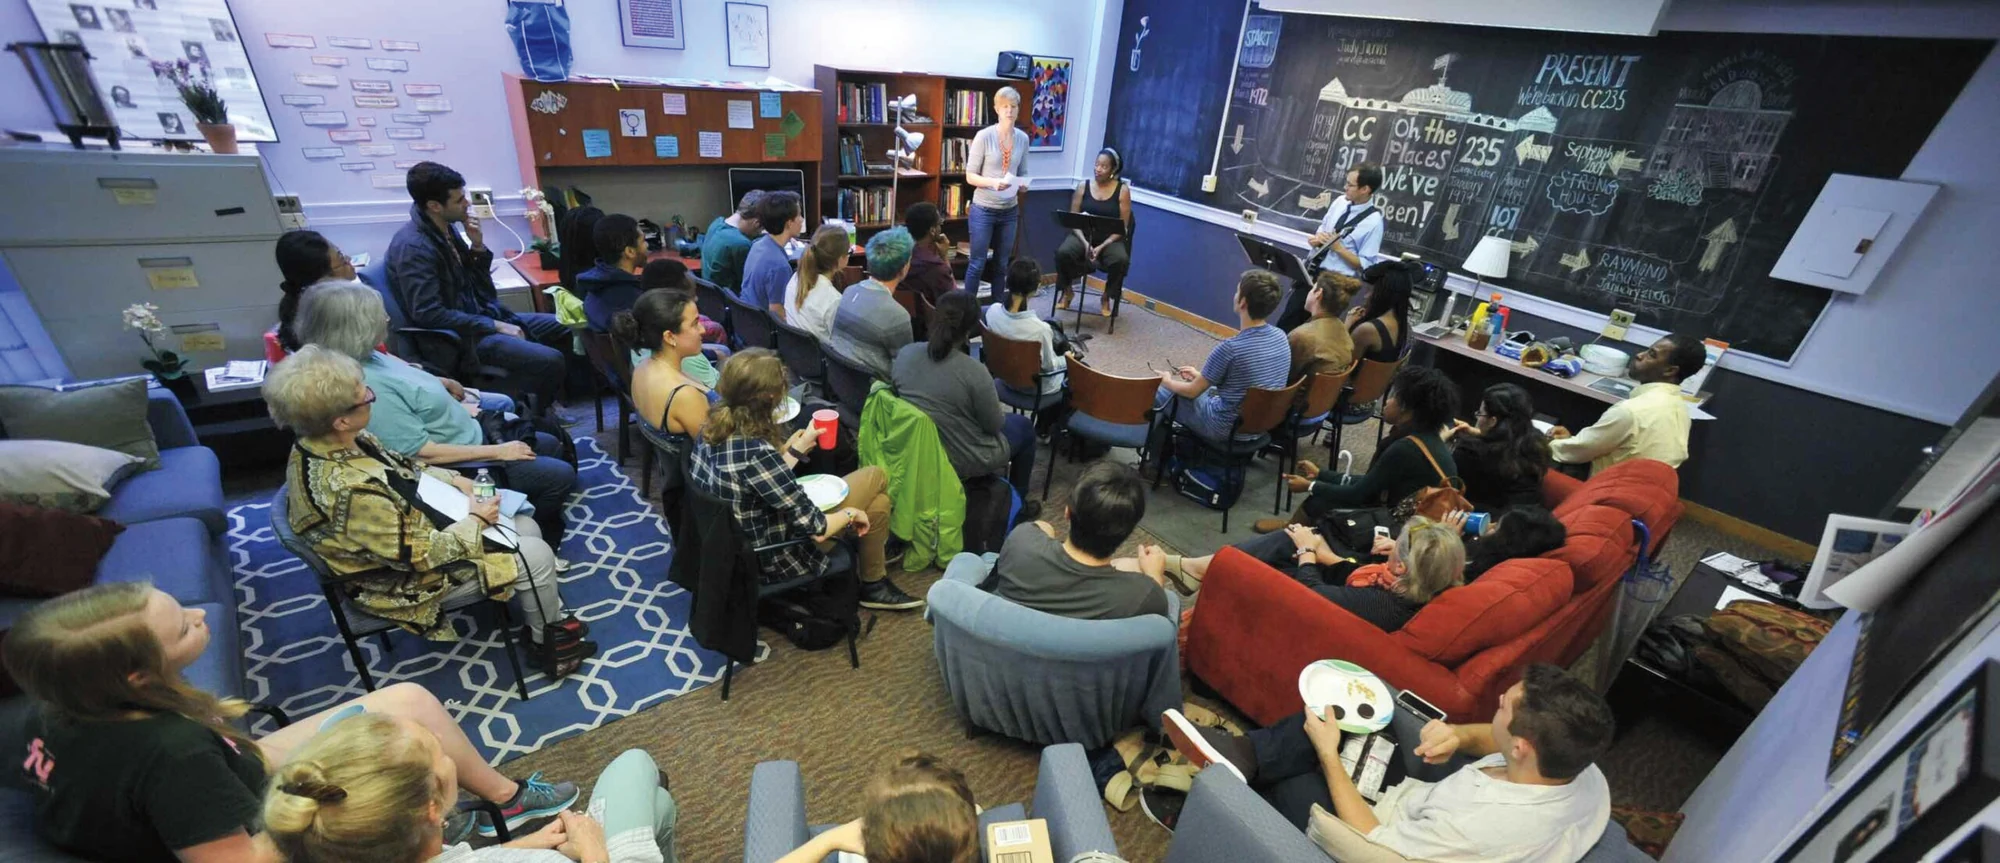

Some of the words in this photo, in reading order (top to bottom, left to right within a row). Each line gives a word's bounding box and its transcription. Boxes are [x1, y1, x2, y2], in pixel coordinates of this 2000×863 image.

[1244, 29, 1273, 47] START
[1336, 38, 1360, 59] Judy
[1535, 53, 1642, 88] PRESENT
[1343, 115, 1377, 142] CC
[1424, 118, 1457, 146] the
[1335, 146, 1368, 170] 317
[1382, 141, 1451, 170] Places
[1459, 136, 1505, 166] 235
[1379, 165, 1439, 196] We've
[1553, 170, 1619, 196] STRONG
[1559, 188, 1601, 208] HOUSE
[1374, 195, 1434, 229] Been!
[1489, 205, 1521, 230] 107
[1600, 252, 1668, 282] RAYMOND
[1607, 270, 1647, 288] HOUSE
[1596, 277, 1641, 303] January
